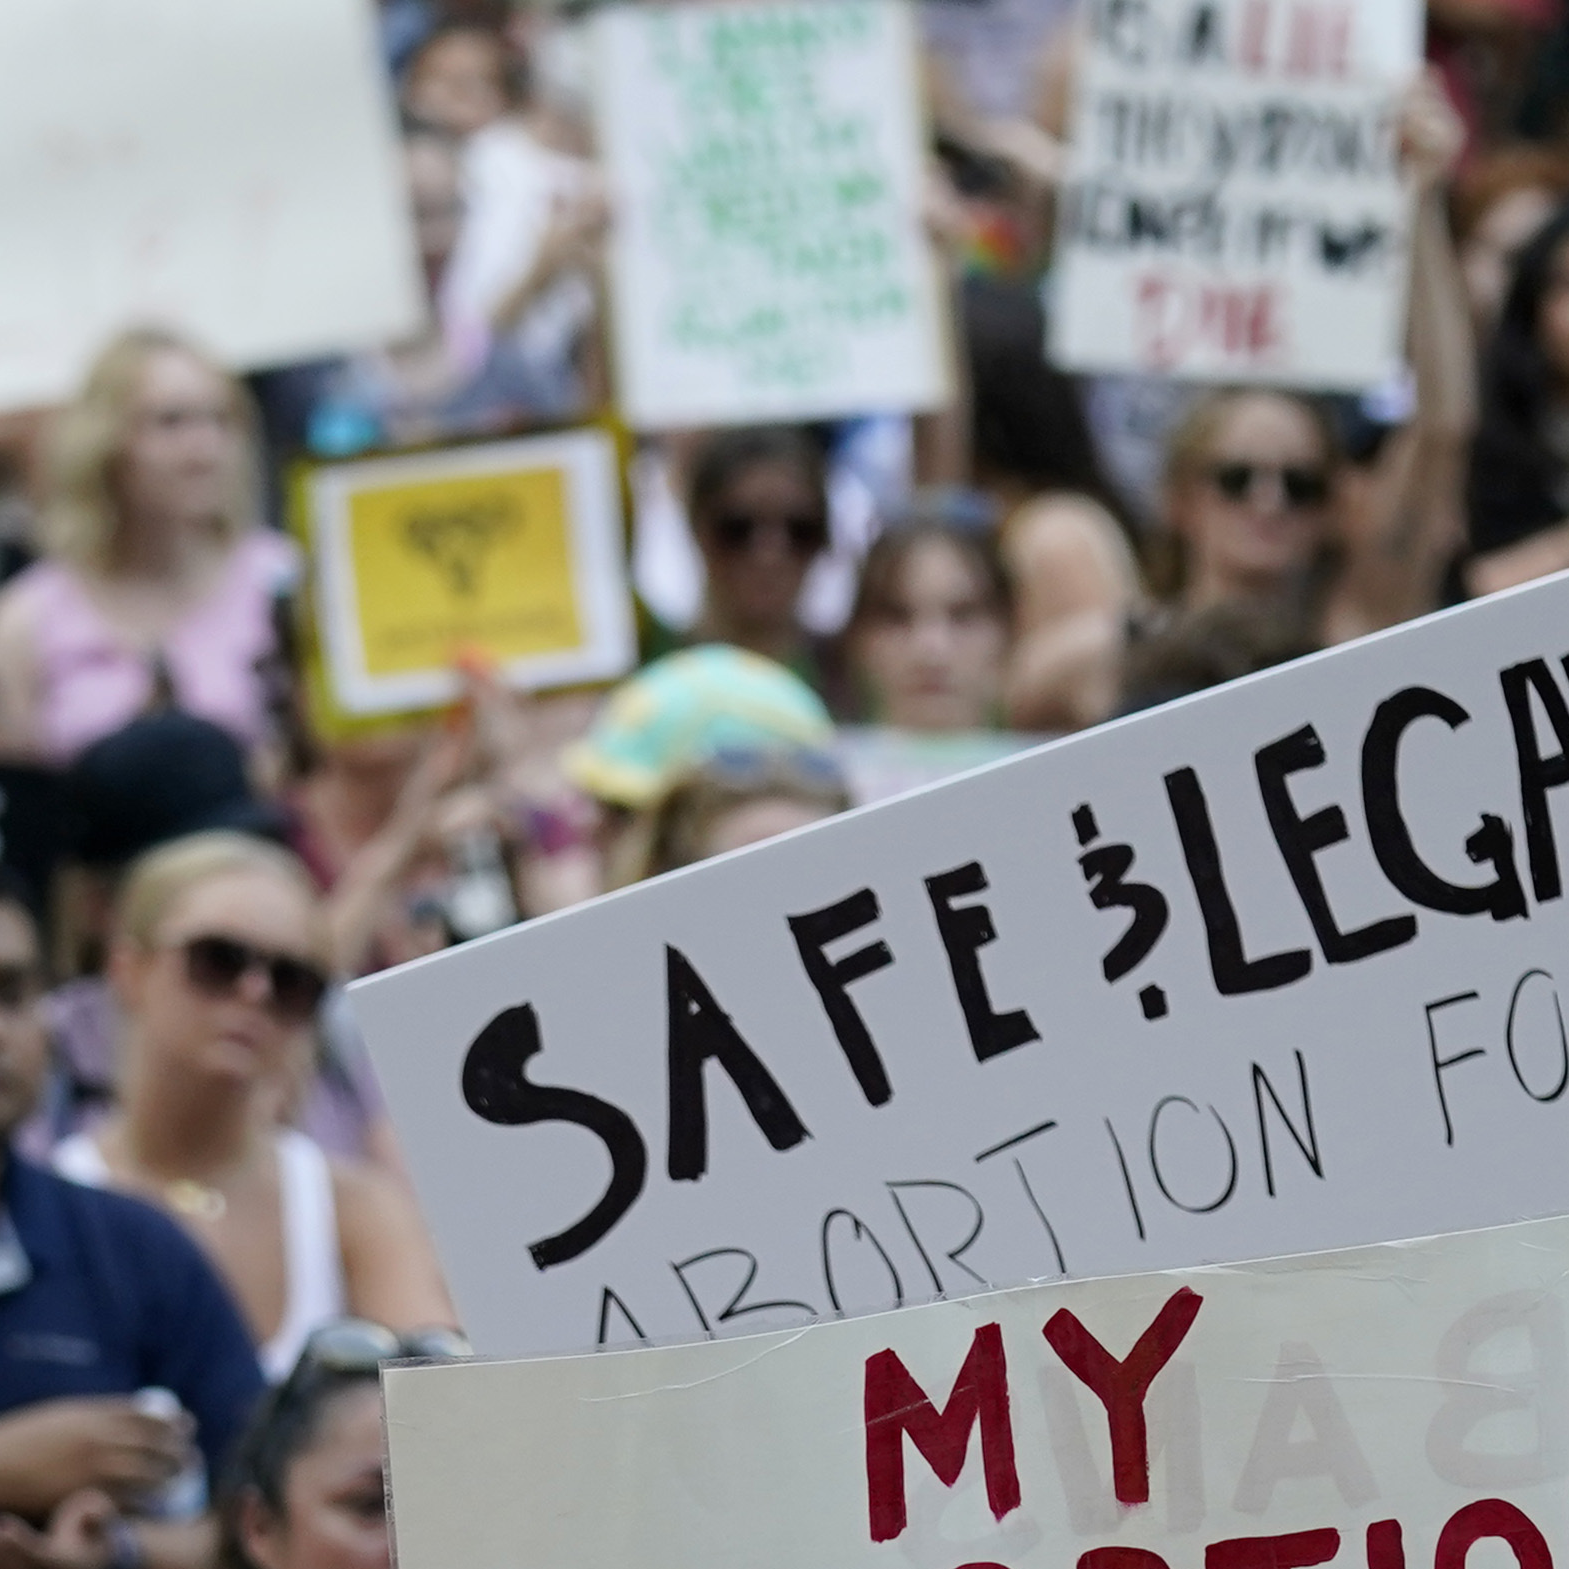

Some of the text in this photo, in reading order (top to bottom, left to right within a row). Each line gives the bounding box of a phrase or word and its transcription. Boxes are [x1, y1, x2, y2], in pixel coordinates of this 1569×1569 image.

[461, 862, 1041, 1272] SAFE
[1072, 804, 1171, 1022] &
[597, 1046, 1327, 1348] ABORTION
[865, 1286, 1203, 1544] MY
